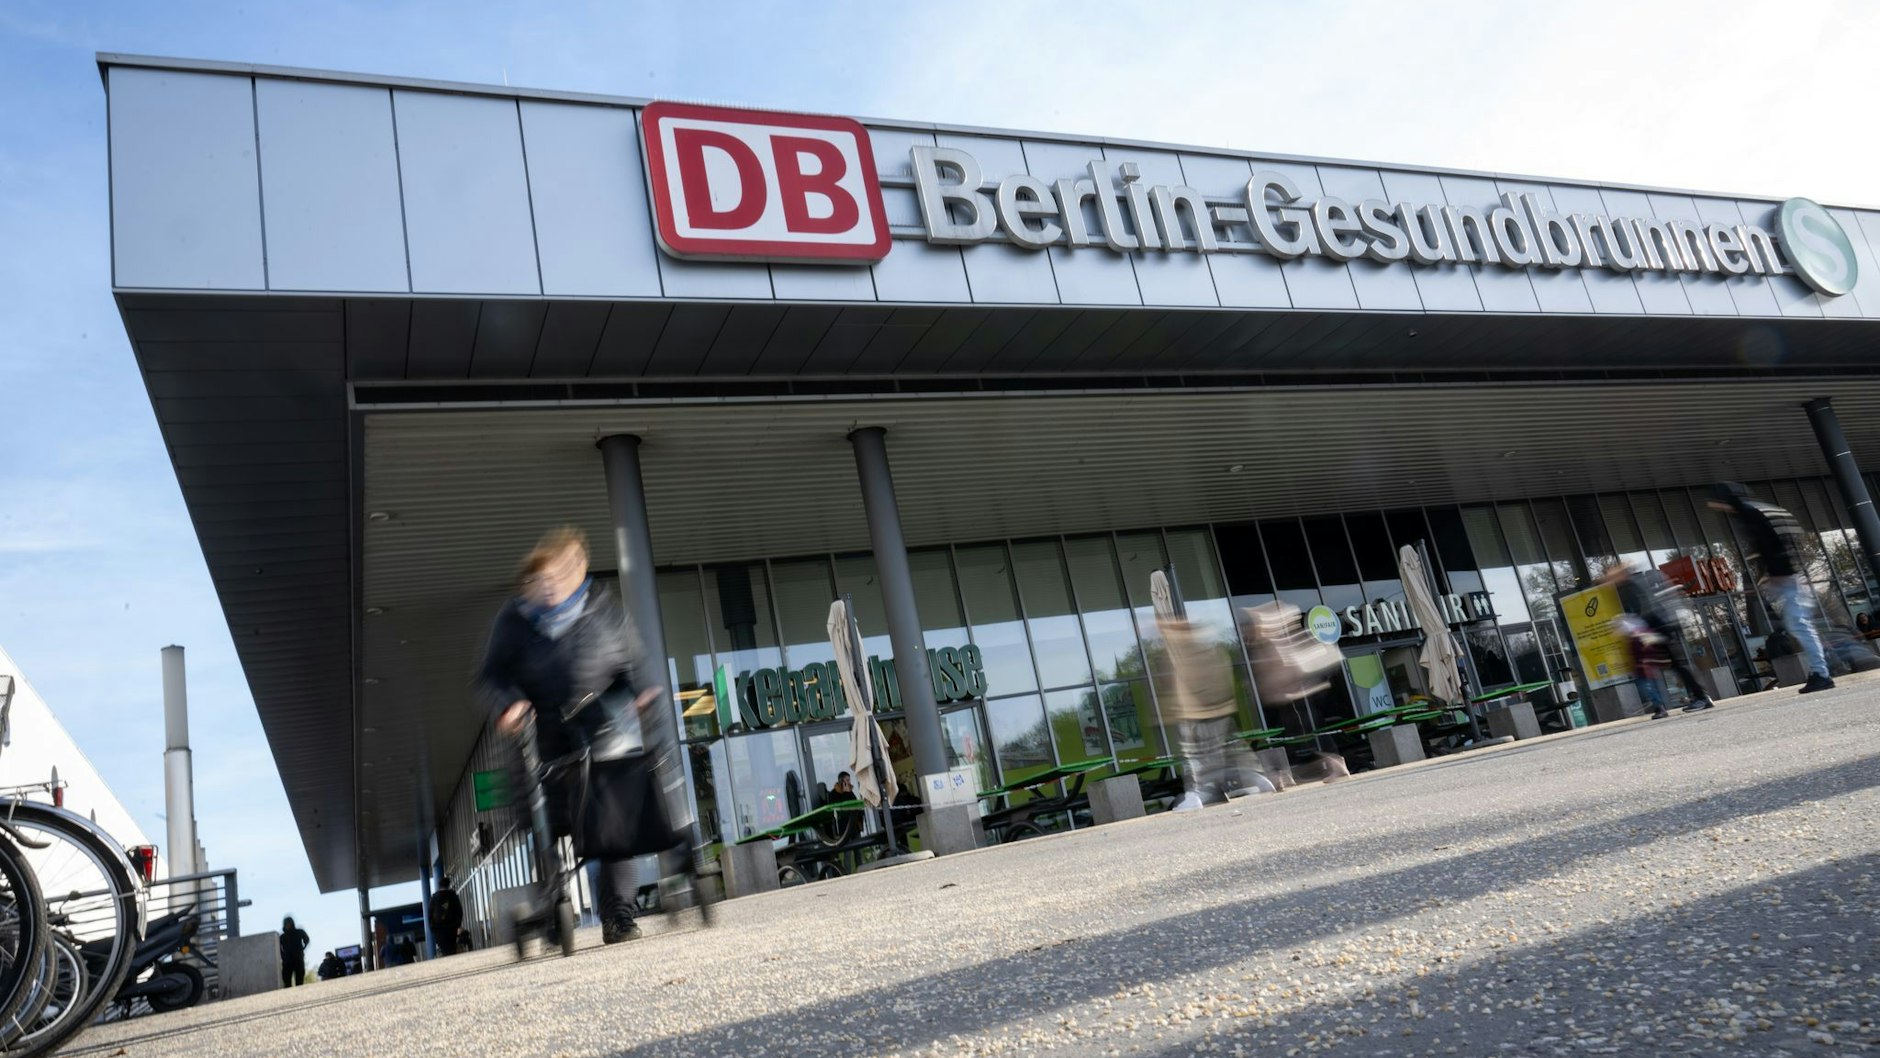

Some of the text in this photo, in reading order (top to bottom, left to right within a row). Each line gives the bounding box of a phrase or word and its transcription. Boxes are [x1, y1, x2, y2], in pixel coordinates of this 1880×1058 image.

[672, 127, 860, 234] DB
[908, 144, 1784, 276] Berlin-Gesundbrunnen
[1313, 620, 1336, 630] SANIFAIR
[1346, 593, 1469, 637] SANIIR
[868, 643, 988, 710] hse
[1371, 694, 1392, 708] WC
